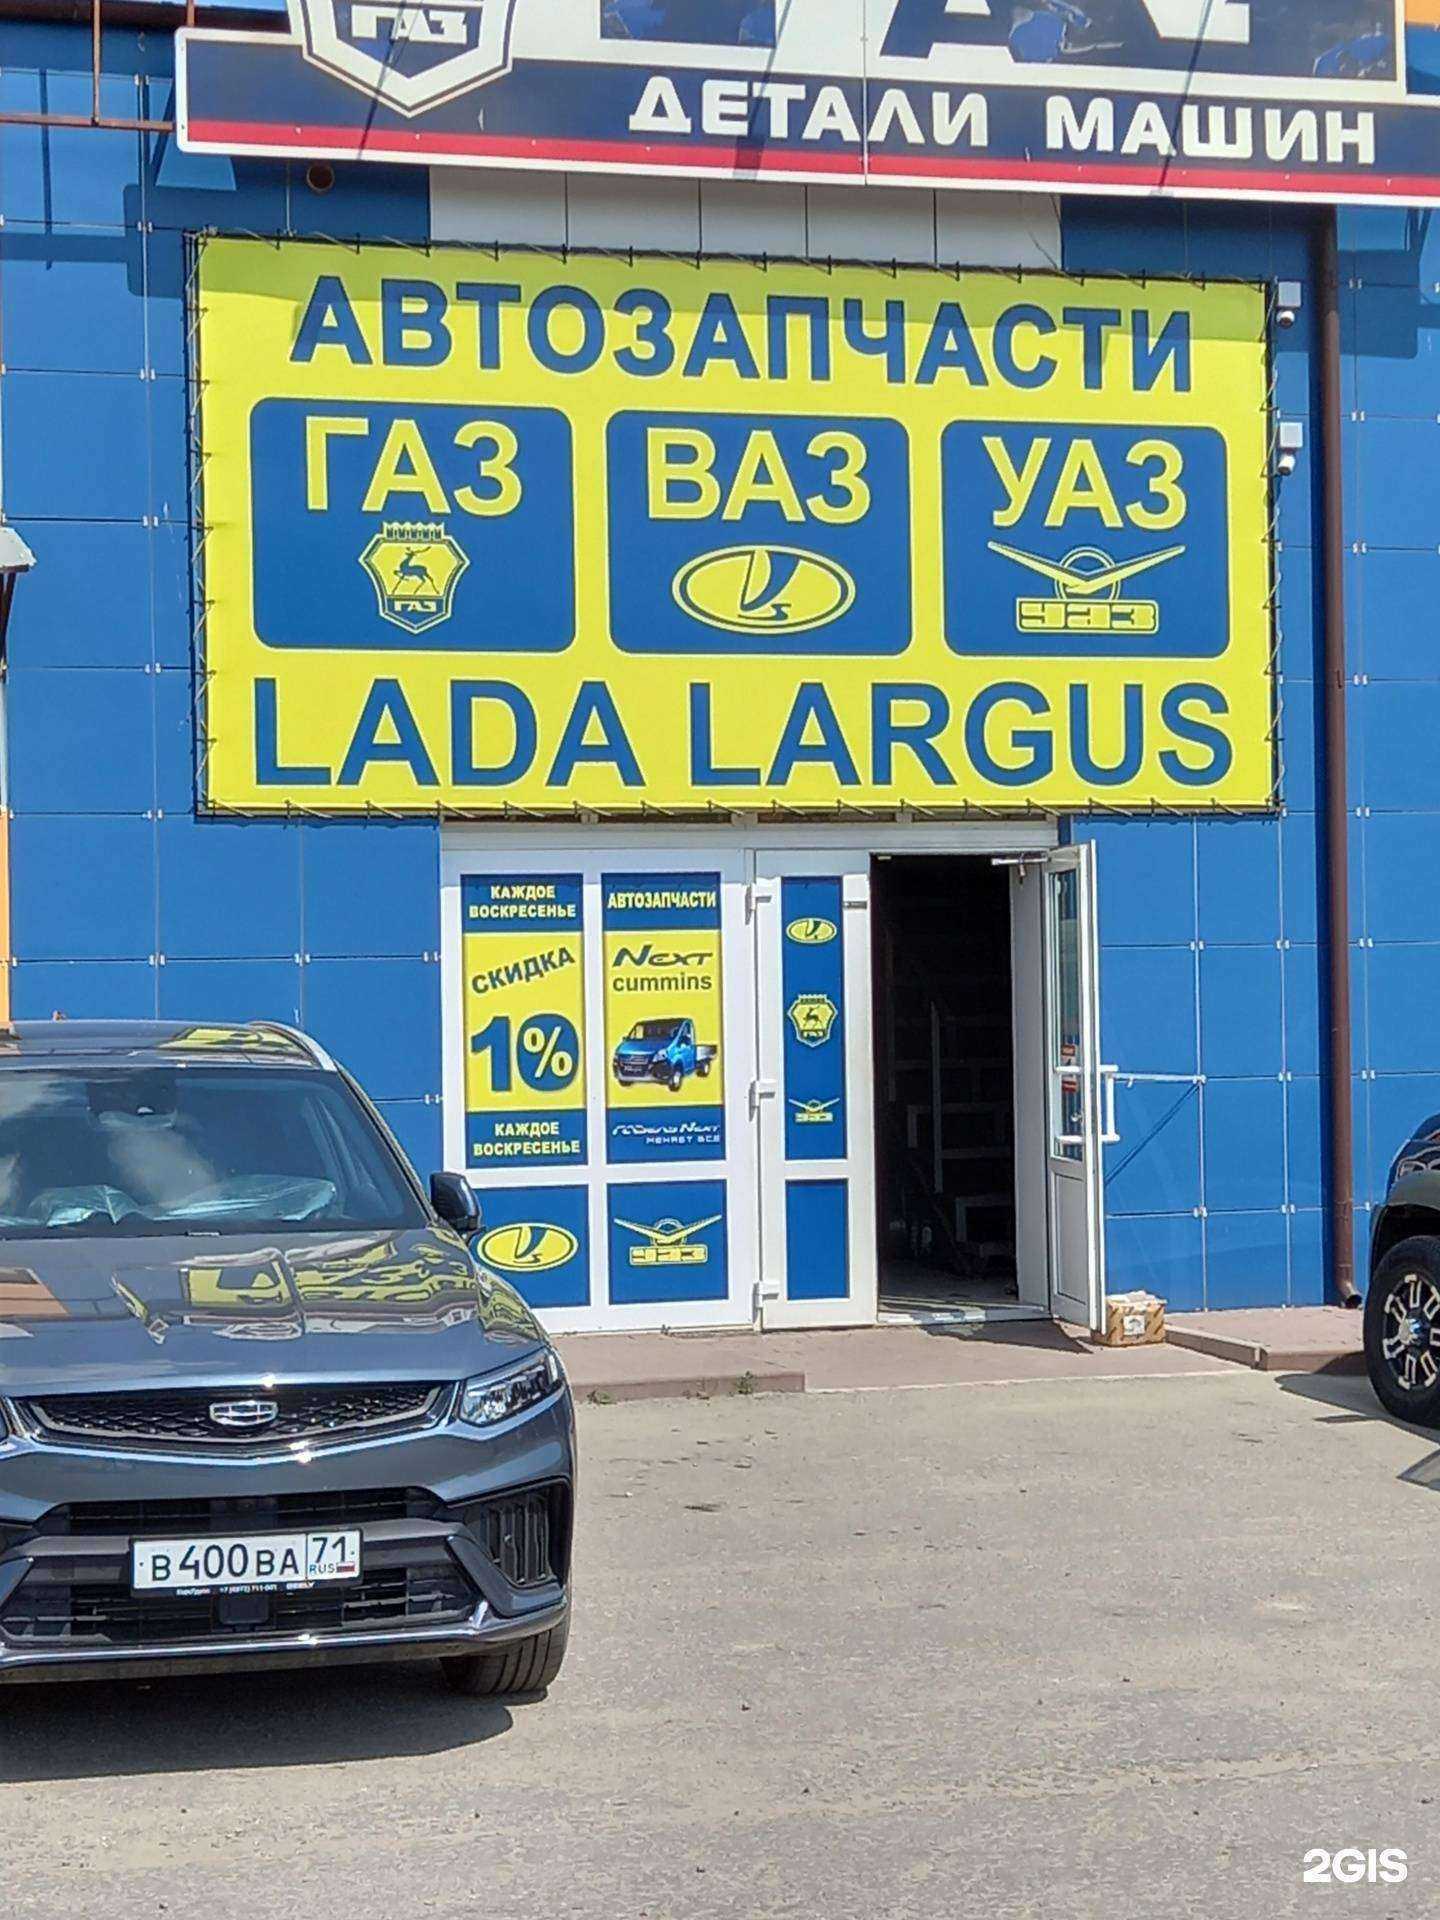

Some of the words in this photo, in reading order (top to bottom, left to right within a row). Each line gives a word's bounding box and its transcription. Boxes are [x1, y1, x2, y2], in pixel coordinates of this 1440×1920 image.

[351, 4, 468, 45] ГАЗ
[629, 76, 989, 147] ДЕТАЛИ
[1045, 94, 1376, 165] МАШИН
[289, 275, 1192, 393] АВТОЗАПЧАСТИ
[304, 416, 522, 517] ГАЗ
[646, 426, 872, 525] ВАЗ
[981, 436, 1188, 530] УАЗ
[253, 677, 646, 787] LADA
[689, 679, 1233, 787] LARGUS
[490, 885, 556, 900] КАЖДОЕ
[607, 892, 717, 909] АВТОЗАПЧАСТИ
[469, 904, 577, 918] ВОСКРЕСЕНЬЕ
[471, 947, 576, 994] СКИДКА
[612, 971, 712, 992] cummins
[494, 1121, 560, 1137] КАЖДОЕ
[473, 1141, 580, 1156] ВОСКРЕСЕНЬЕ
[312, 1536, 347, 1564] 71
[309, 1563, 336, 1576] RUS
